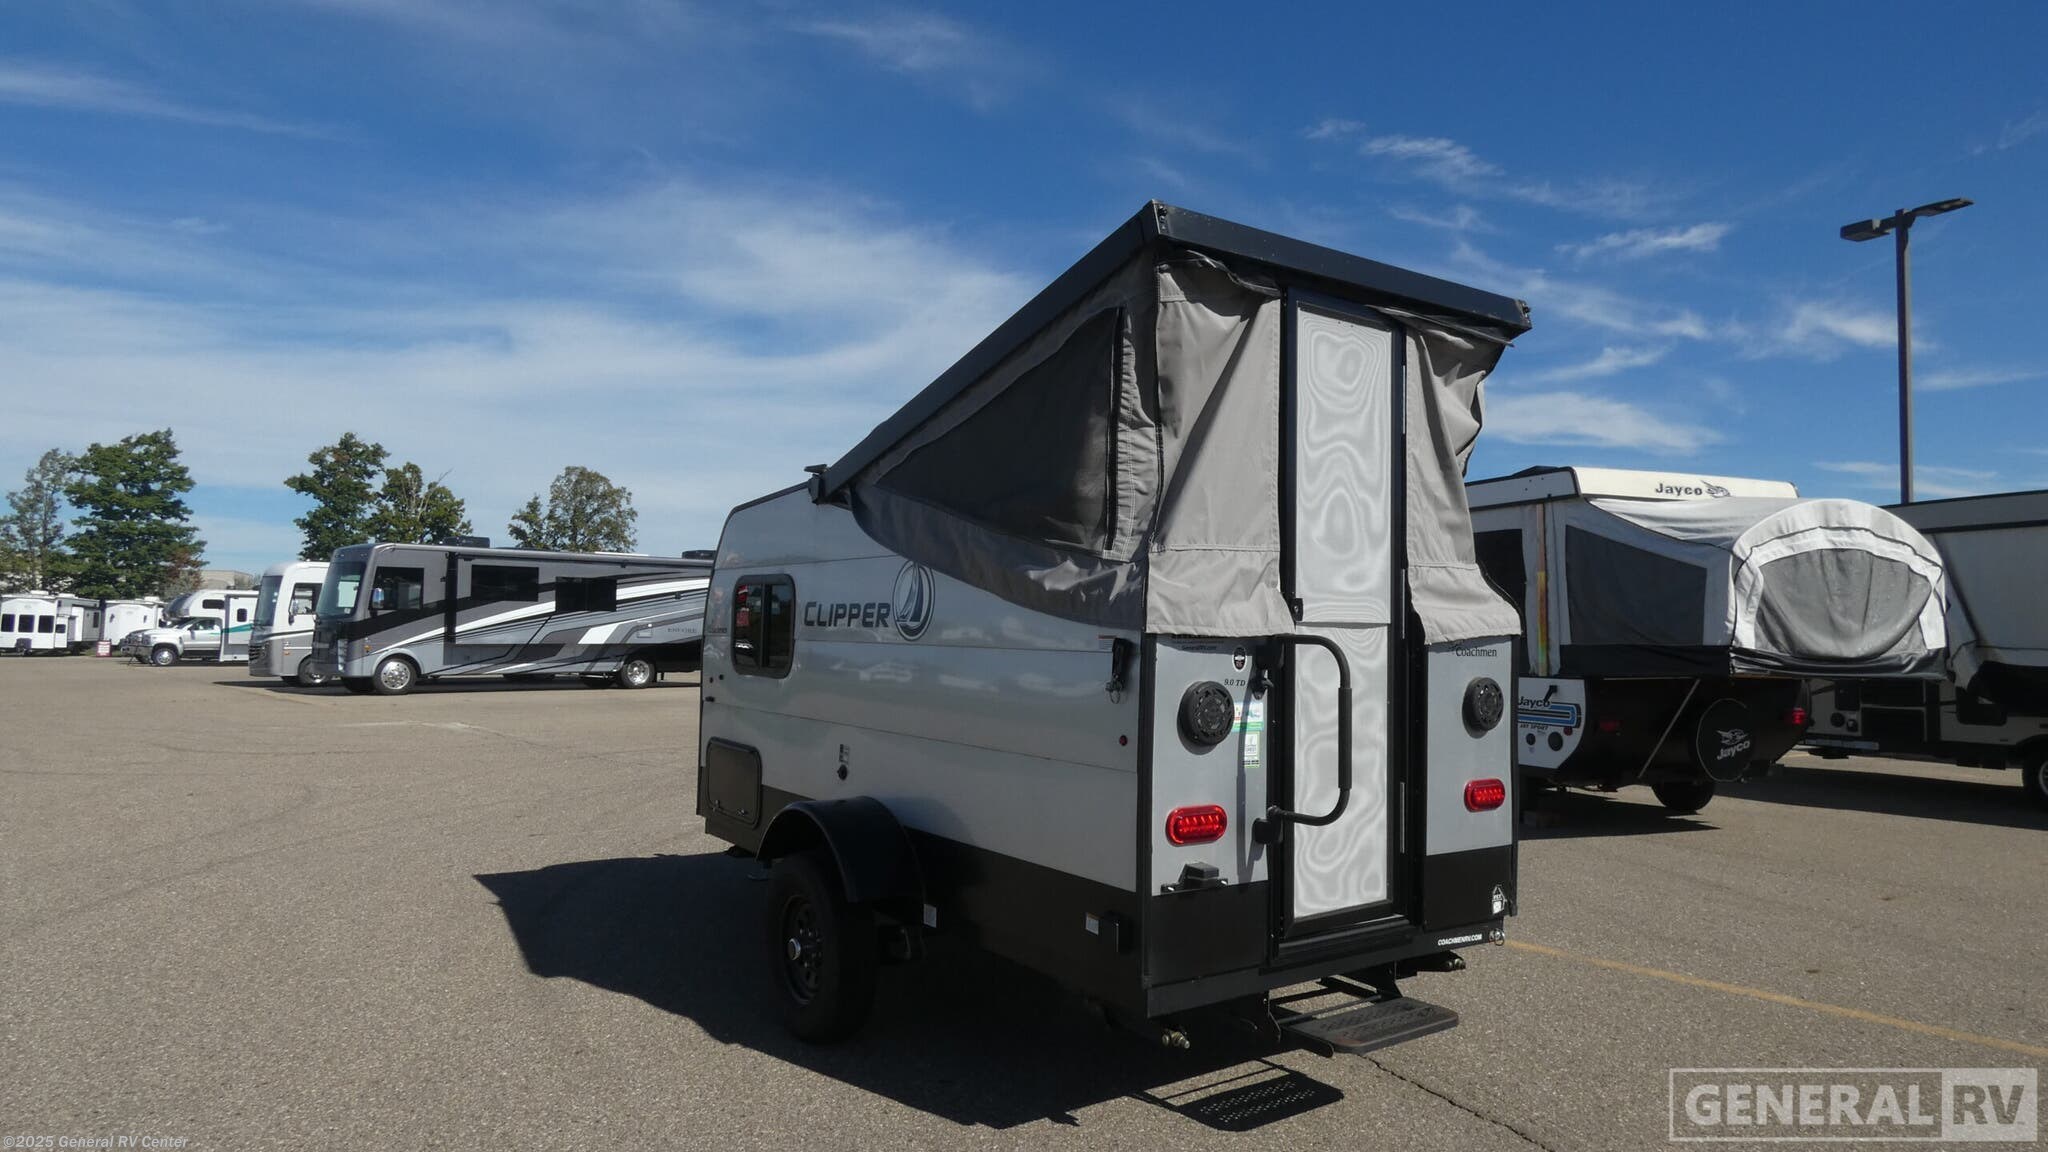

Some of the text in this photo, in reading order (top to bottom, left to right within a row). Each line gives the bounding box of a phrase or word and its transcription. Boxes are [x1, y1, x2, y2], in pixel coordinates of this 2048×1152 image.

[1656, 482, 1703, 496] Jayco
[804, 601, 890, 628] CLIPPER
[1456, 647, 1497, 656] Coachmen
[1518, 695, 1551, 708] Jayco
[1717, 738, 1751, 760] Jayco
[1438, 934, 1482, 945] COACHMENRV.COM
